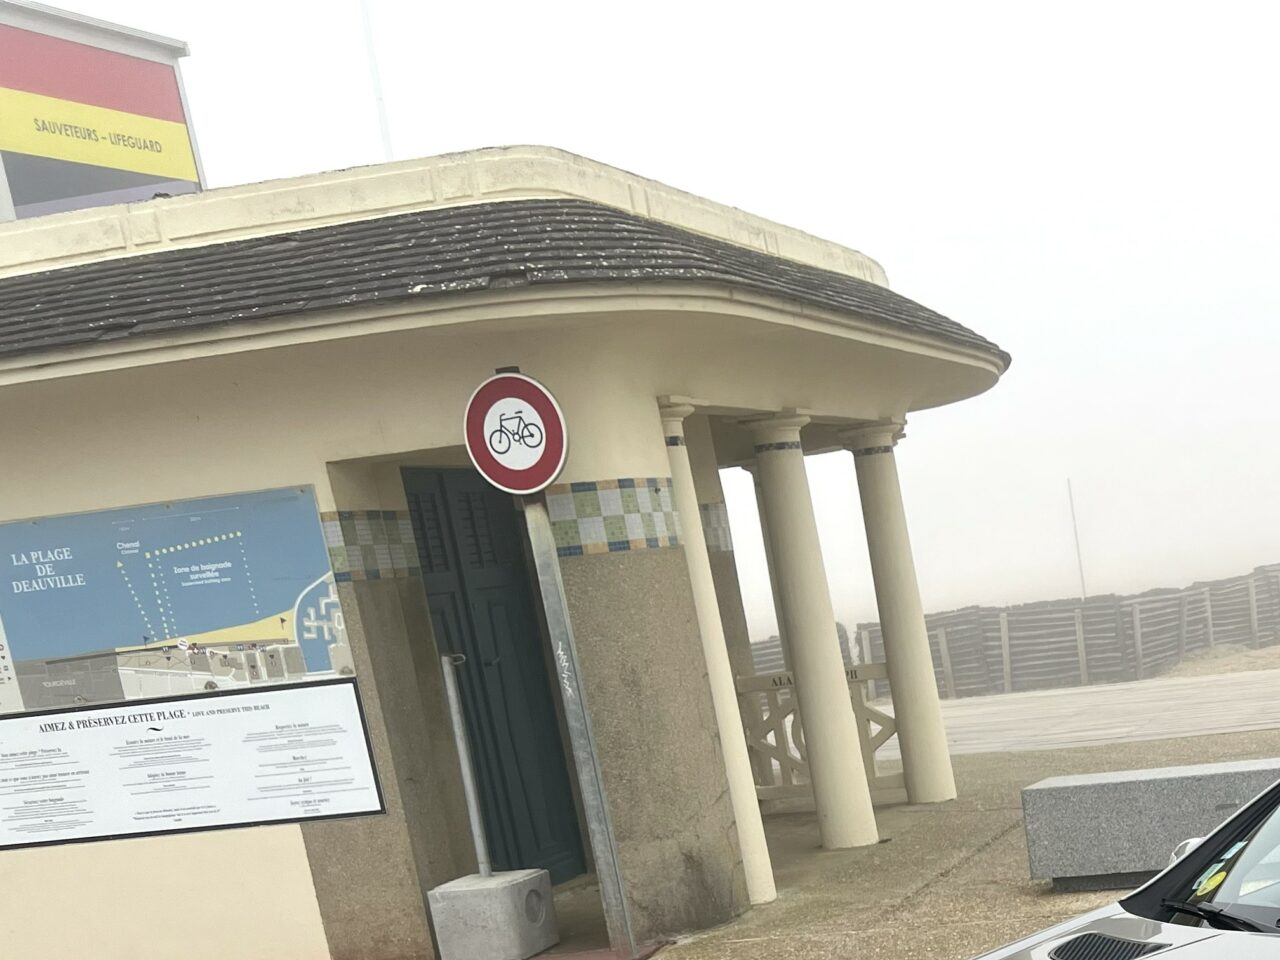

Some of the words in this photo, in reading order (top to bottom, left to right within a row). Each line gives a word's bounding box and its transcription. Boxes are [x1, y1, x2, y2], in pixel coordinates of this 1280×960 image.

[34, 118, 99, 142] SAUVETEURS
[108, 132, 162, 153] LIFEGUARD
[11, 553, 30, 566] LA
[30, 547, 73, 564] PLAGE
[35, 564, 55, 577] DE
[12, 573, 86, 593] DEAUVILLE
[39, 721, 67, 733] AIMEZ
[68, 720, 75, 730] &
[76, 715, 127, 730] PRÉSERVEZ
[127, 712, 156, 724] CETTE
[156, 709, 186, 721] PLAGE
